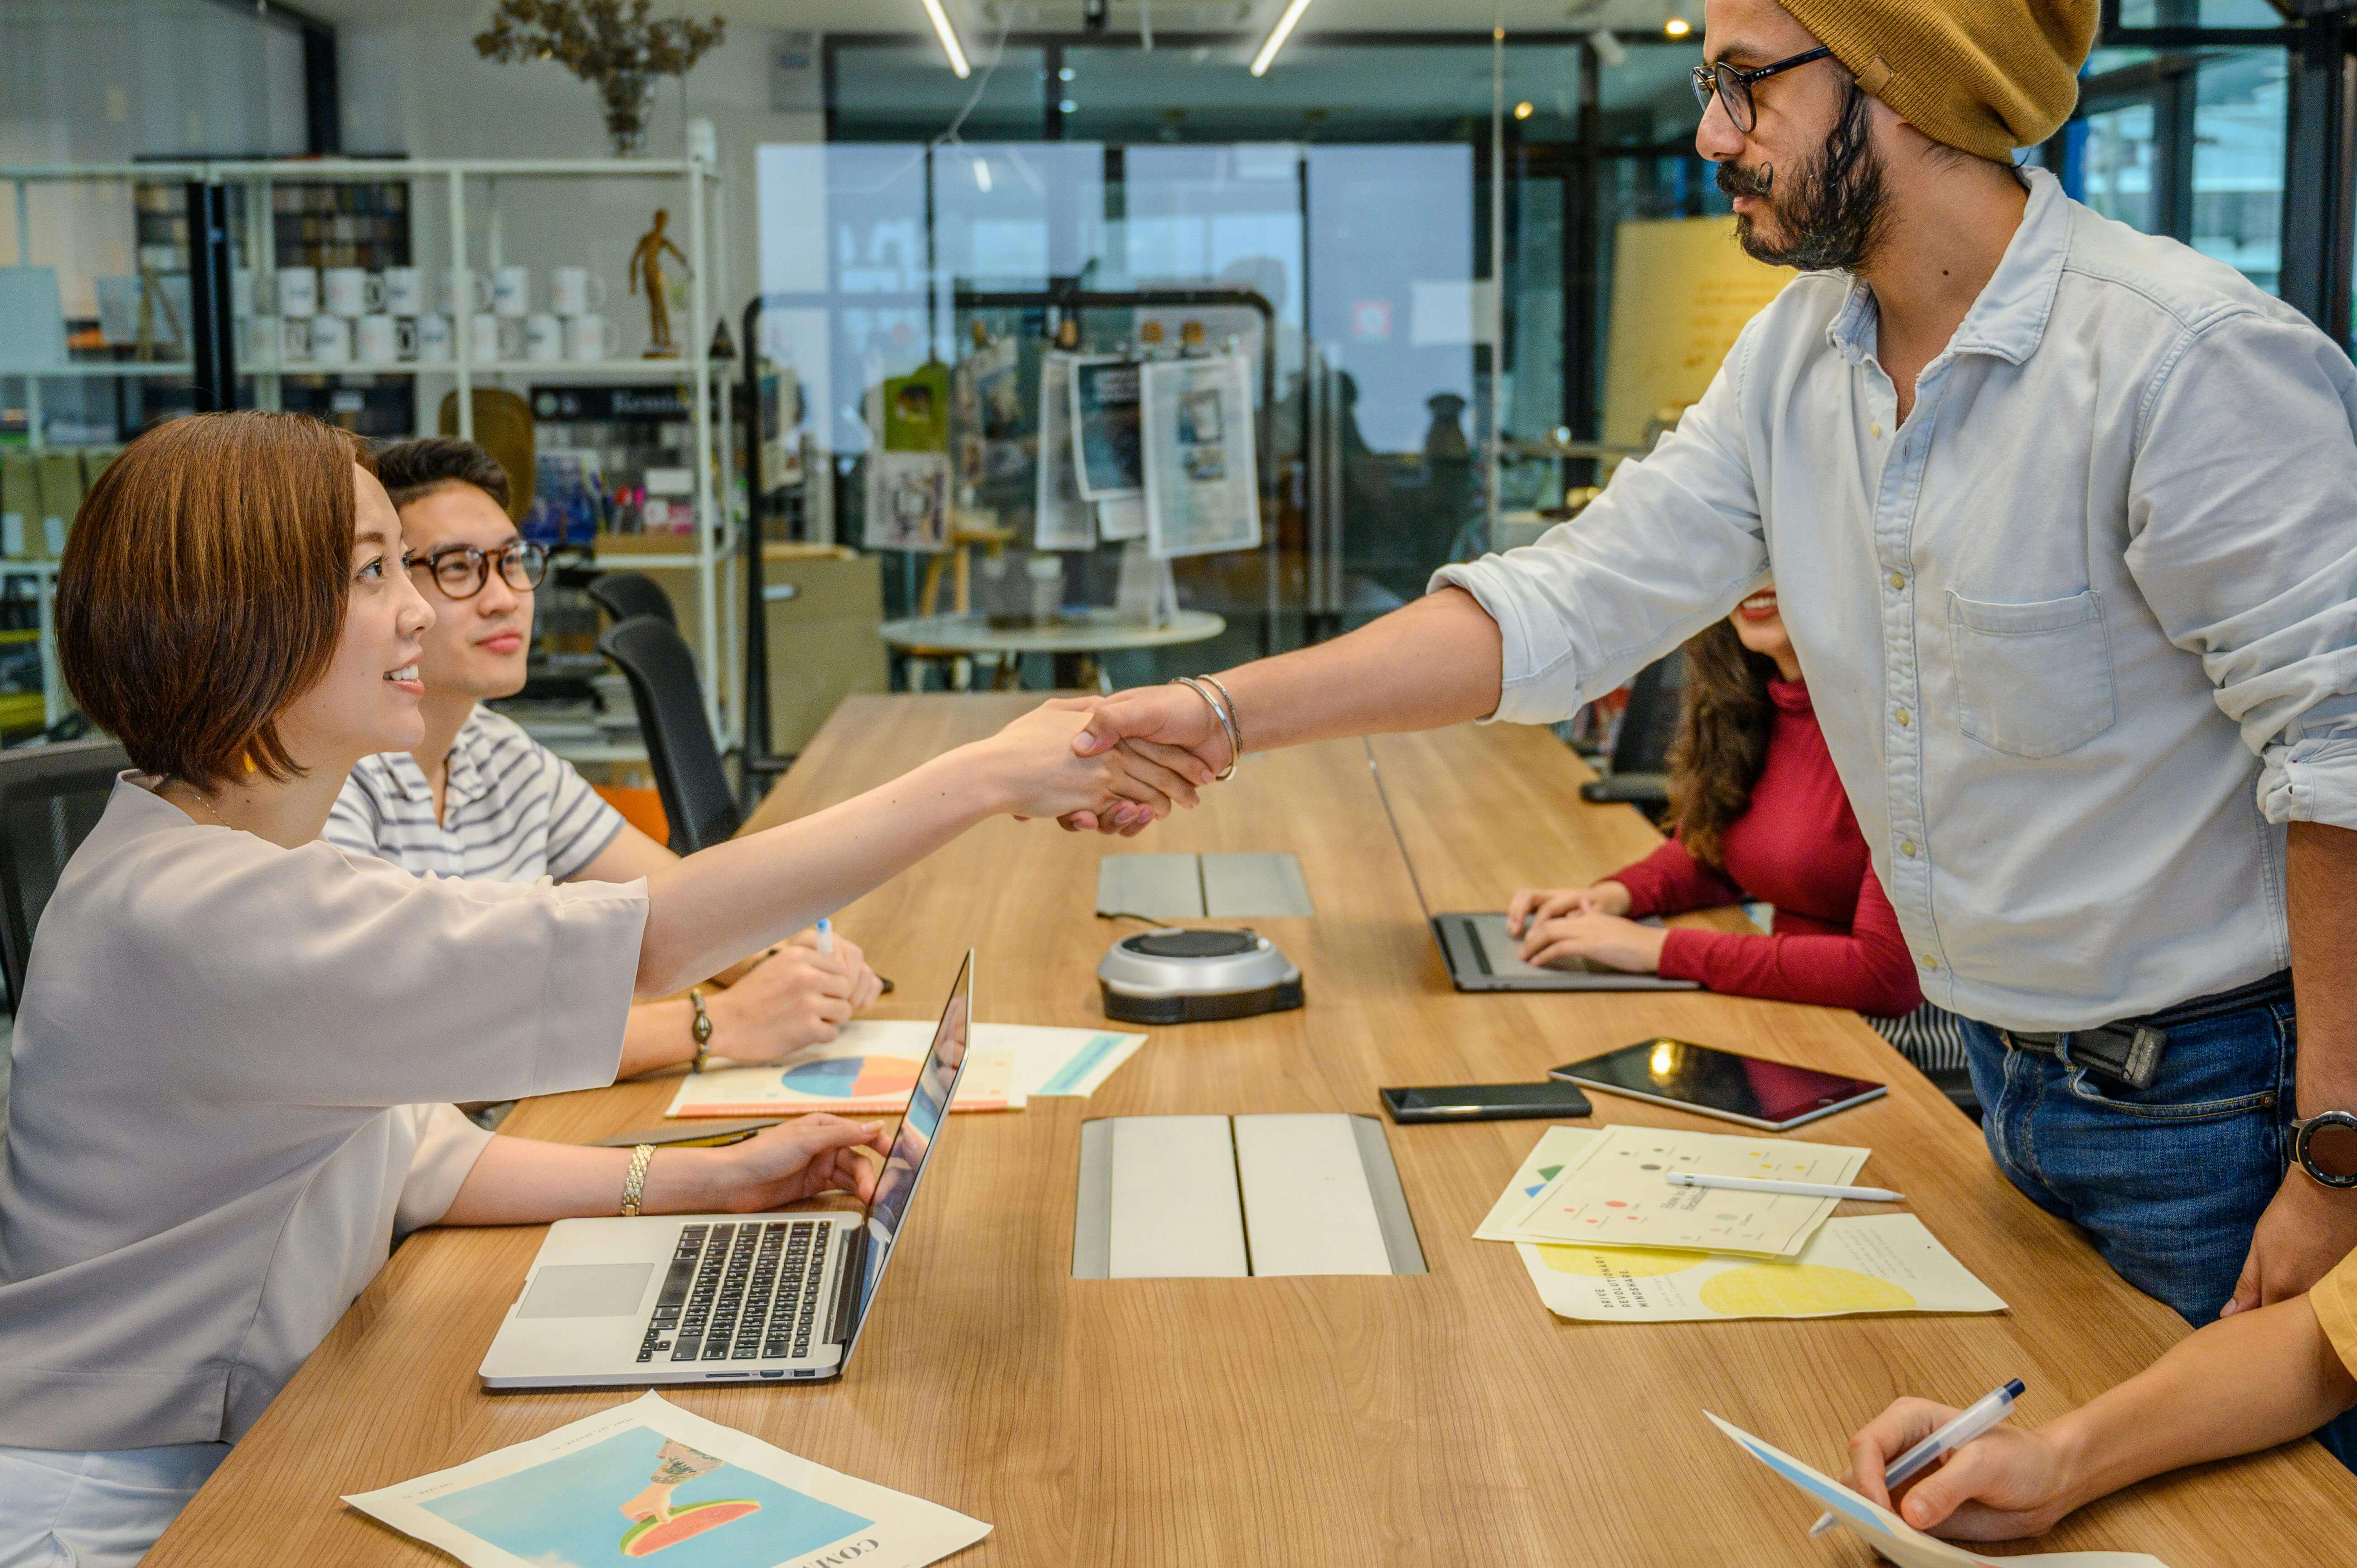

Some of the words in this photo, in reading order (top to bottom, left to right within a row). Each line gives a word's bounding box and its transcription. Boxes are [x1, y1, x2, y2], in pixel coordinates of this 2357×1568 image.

[1594, 1256, 1631, 1307] REVOLUTIONARY
[1595, 1288, 1614, 1307] DRIVE
[803, 1539, 879, 1568] COM
